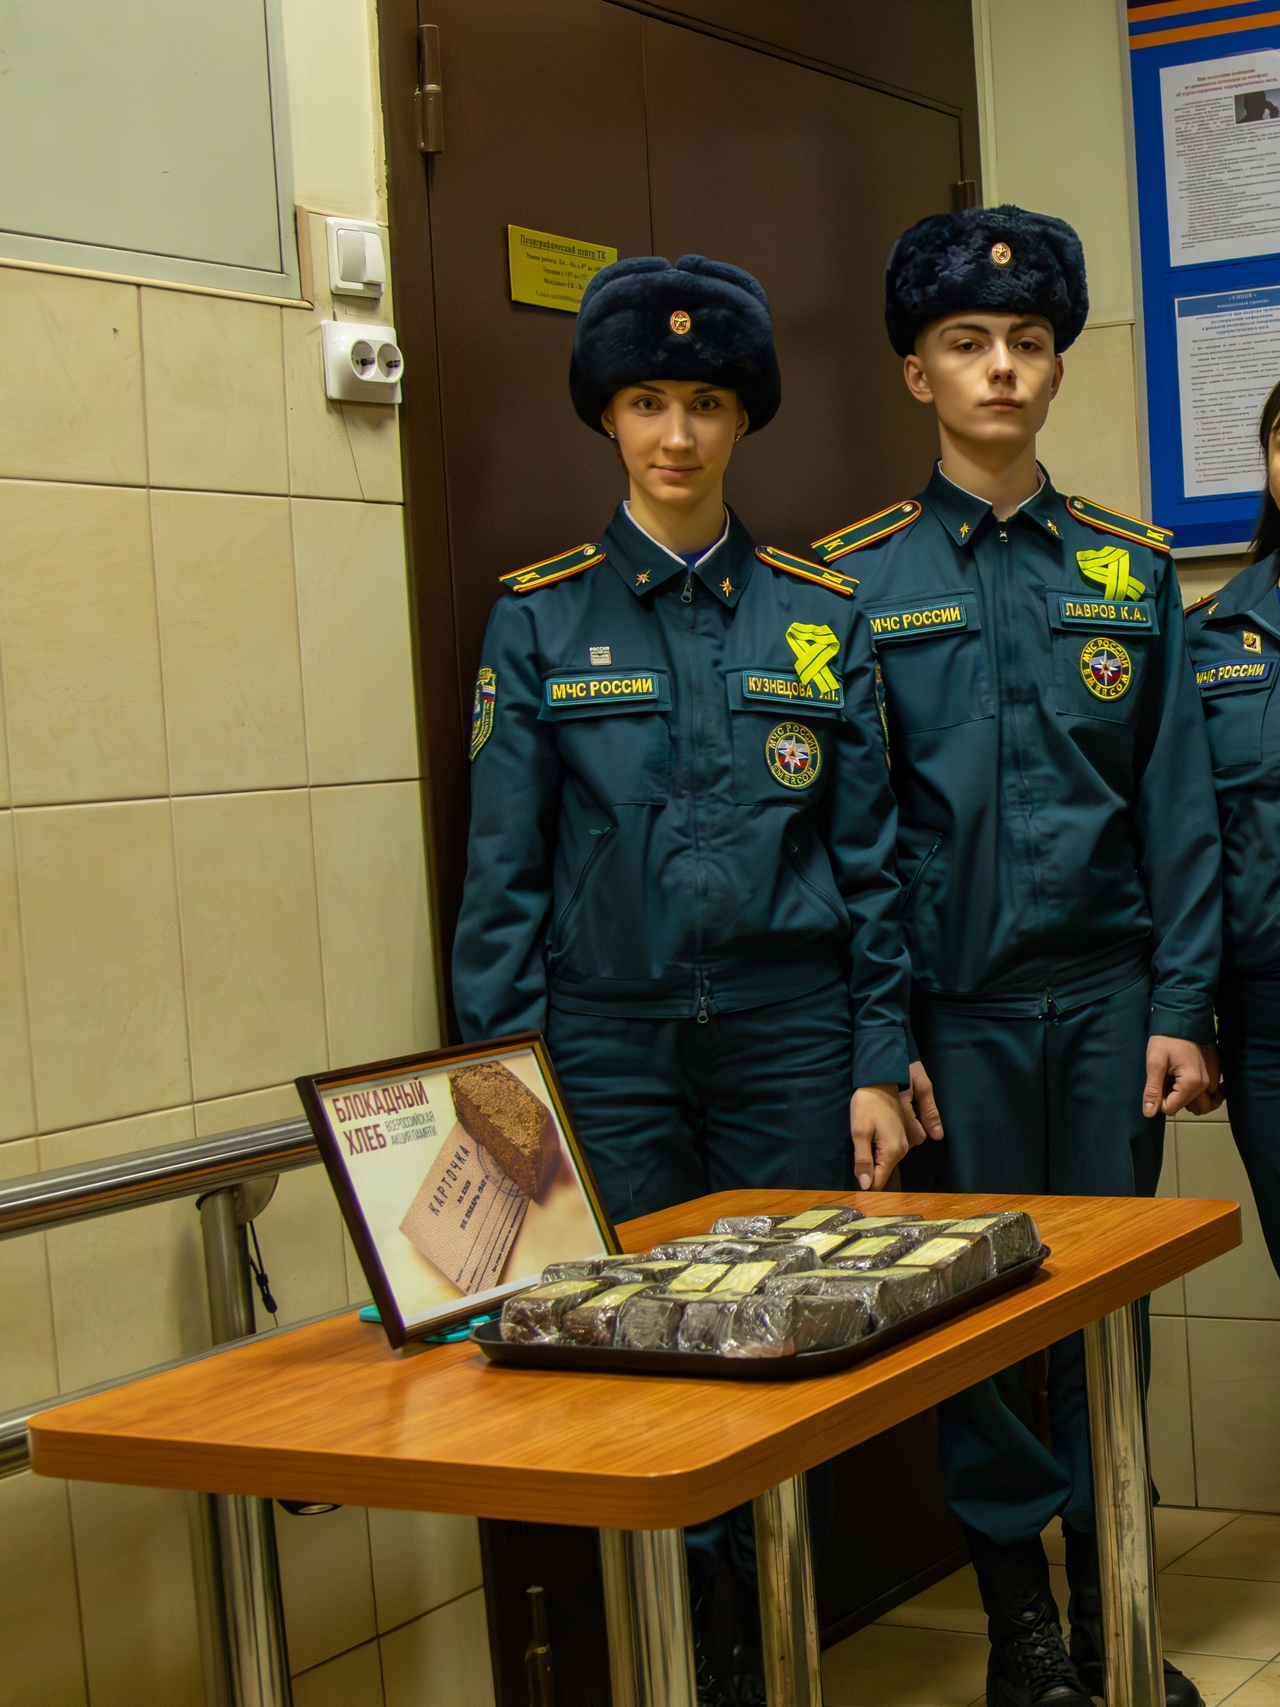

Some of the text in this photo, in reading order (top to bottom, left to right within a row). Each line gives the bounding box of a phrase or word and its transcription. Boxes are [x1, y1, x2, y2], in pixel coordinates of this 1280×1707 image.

[597, 250, 606, 260] ТК
[902, 606, 961, 628] РОССИИ
[1066, 603, 1146, 621] ЛАВРОВ К.А.
[1082, 640, 1129, 668] МЧС РОССИИ
[1083, 668, 1129, 696] EMERCOM
[1218, 664, 1265, 680] РОССИИ
[552, 678, 652, 699] МЧС РОССИИ
[748, 677, 813, 699] КУЗНЕЦОВА
[769, 724, 817, 755] МЧС РОССИИ
[771, 762, 815, 784] EMERCOM
[332, 1076, 429, 1123] БЛОКАДНЫЙ
[385, 1111, 436, 1132] ВСЕРОССИЙСКАЯ
[343, 1124, 388, 1156] ХЛЕБ
[390, 1125, 438, 1146] АКЦИЯ ПАМЯТИ
[428, 1145, 470, 1216] КАРТОЧКА
